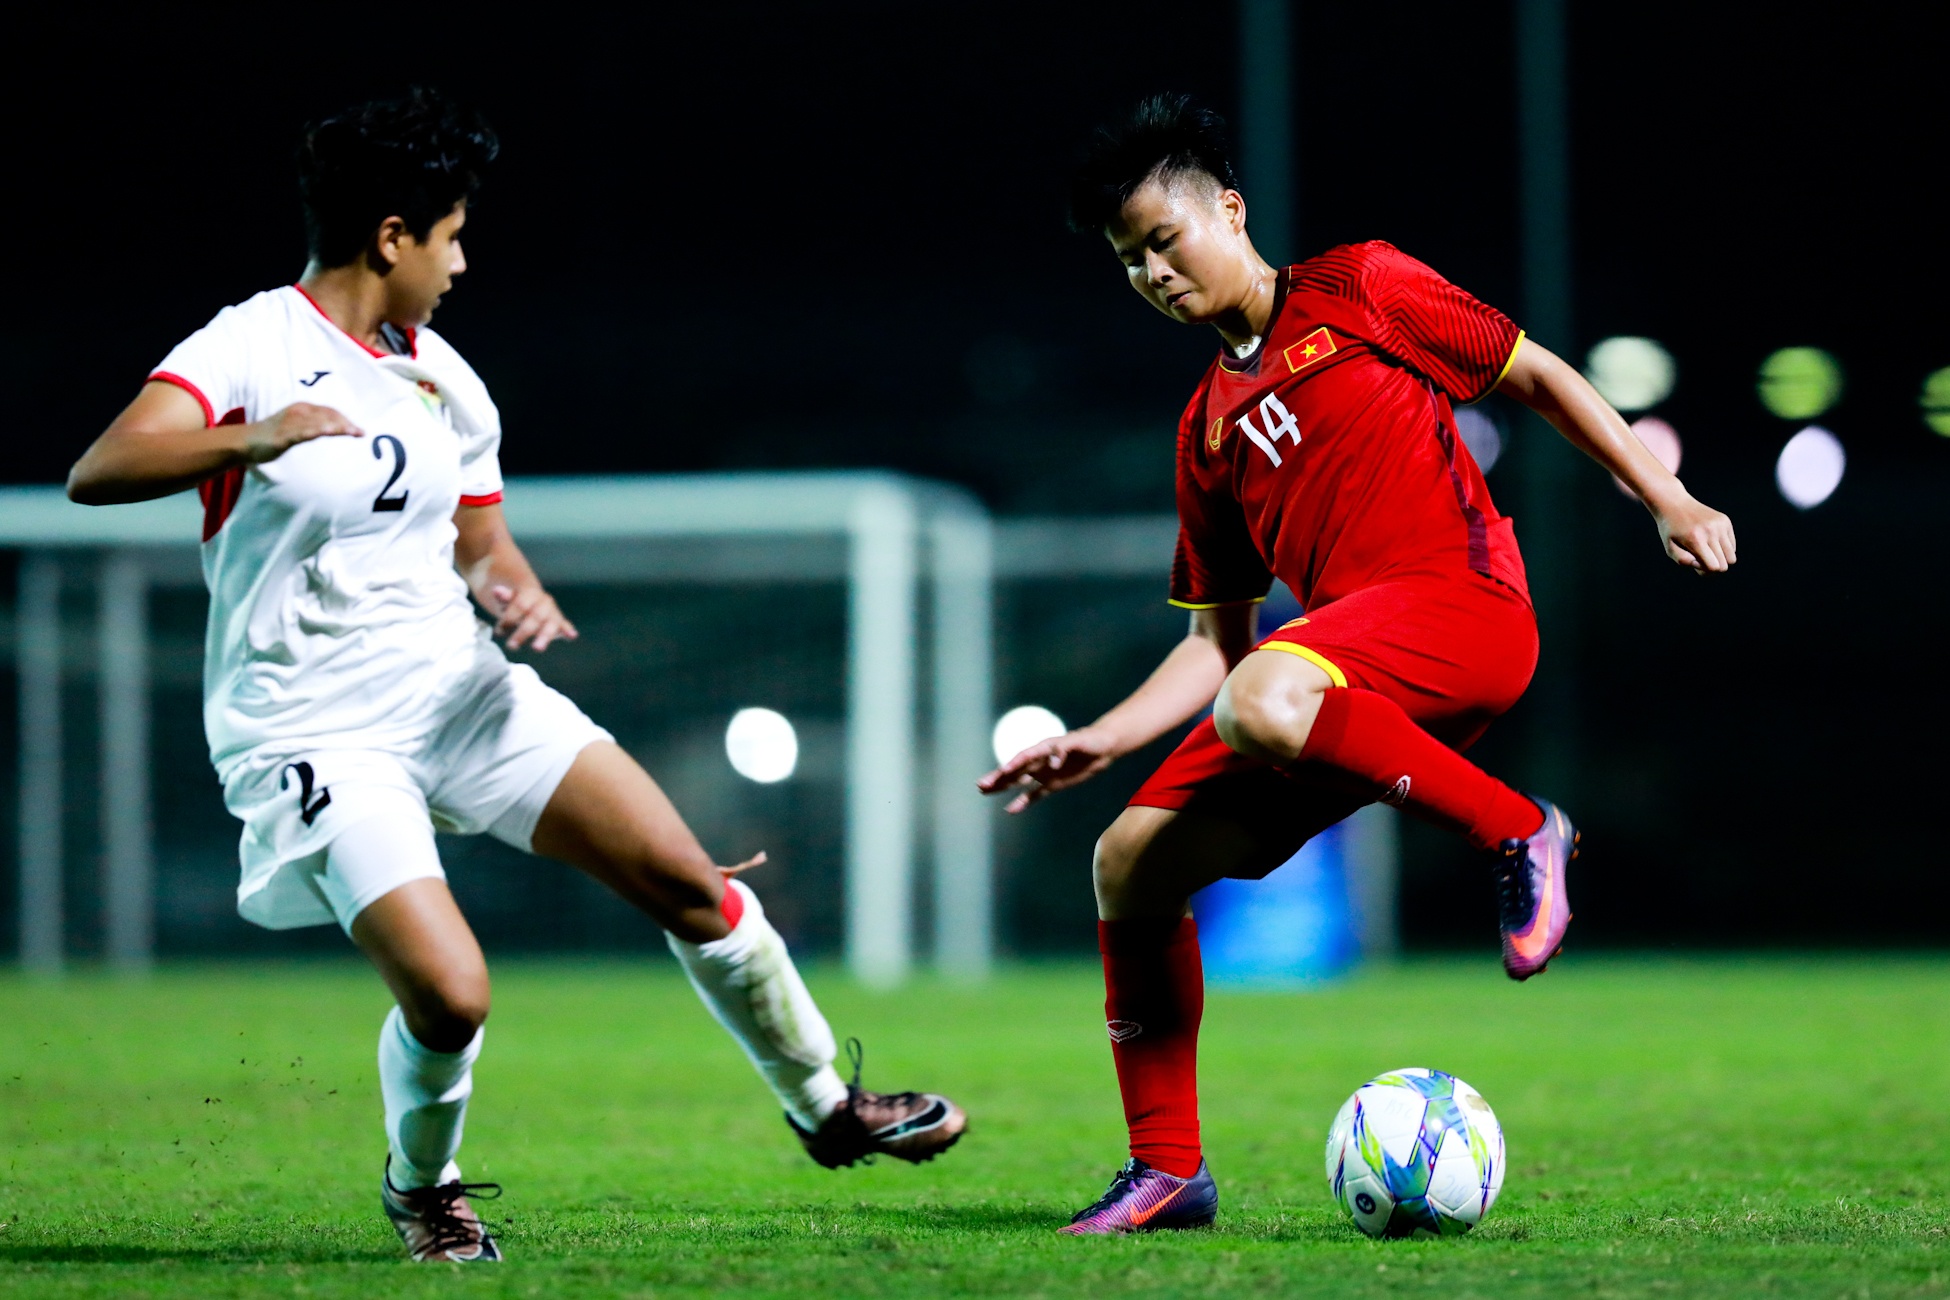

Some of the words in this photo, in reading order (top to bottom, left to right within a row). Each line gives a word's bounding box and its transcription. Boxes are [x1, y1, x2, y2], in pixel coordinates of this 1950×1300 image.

[1235, 391, 1303, 469] 14
[372, 434, 409, 512] 2
[280, 761, 332, 829] 2
